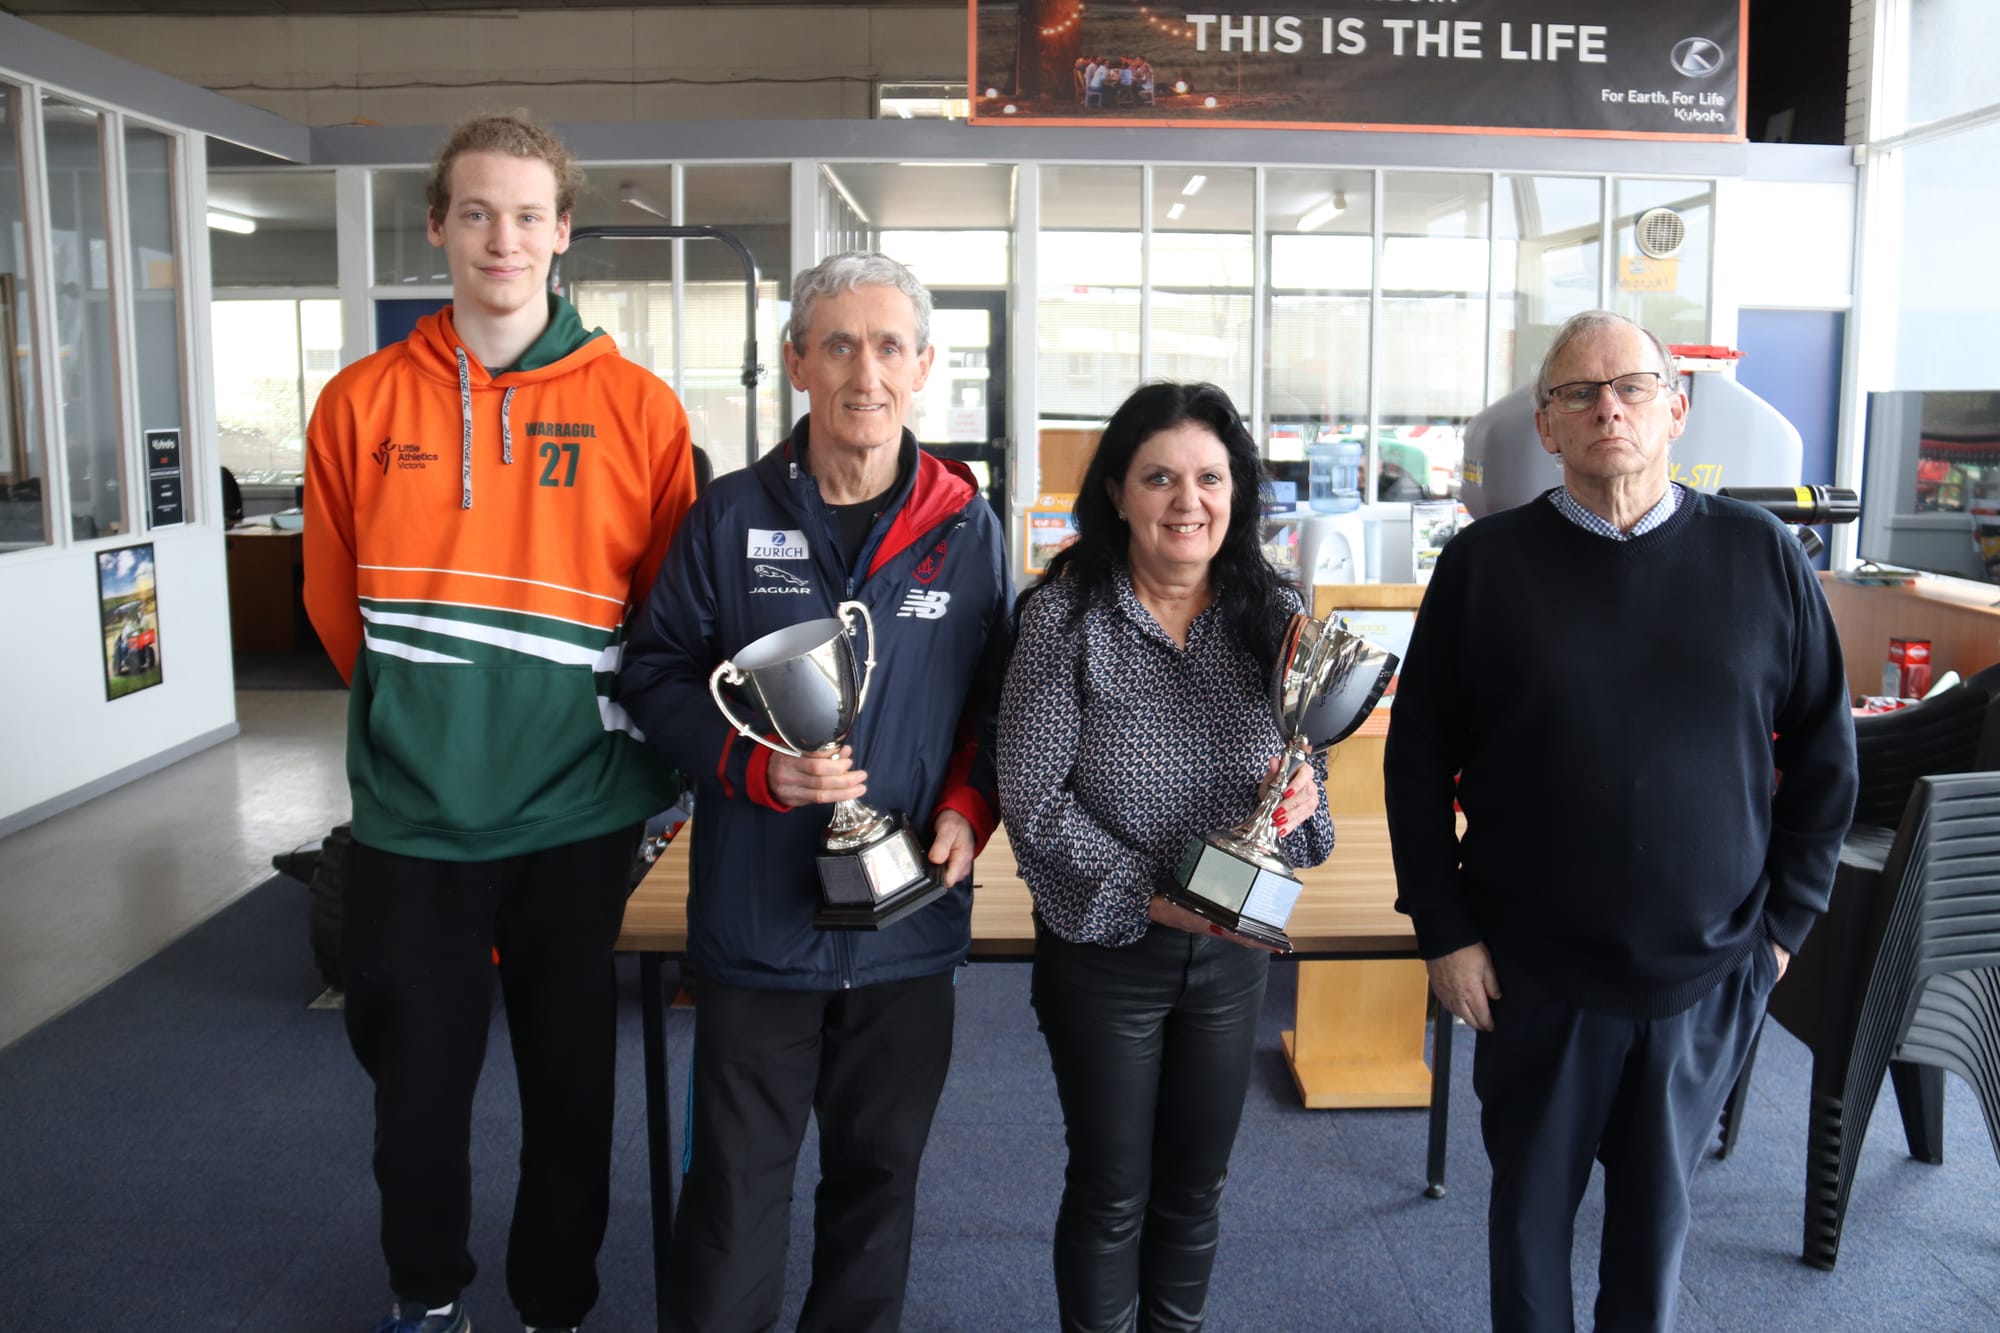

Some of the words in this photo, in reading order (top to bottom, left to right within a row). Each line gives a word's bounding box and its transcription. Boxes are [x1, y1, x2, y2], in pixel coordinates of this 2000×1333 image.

[1186, 14, 1304, 54] THIS
[1322, 17, 1367, 55] IS
[1383, 19, 1483, 58] THE
[1500, 22, 1608, 63] LIFE
[1601, 88, 1624, 103] For
[1628, 89, 1669, 105] Earth,
[1672, 91, 1695, 105] For
[1699, 92, 1726, 106] Life
[1674, 108, 1725, 122] Kubota
[525, 421, 597, 438] WARRAGUL
[398, 444, 420, 453] Little
[398, 453, 439, 461] Athletics
[539, 441, 581, 488] 27
[753, 547, 803, 558] ZURICH
[748, 587, 811, 595] JAGUAR
